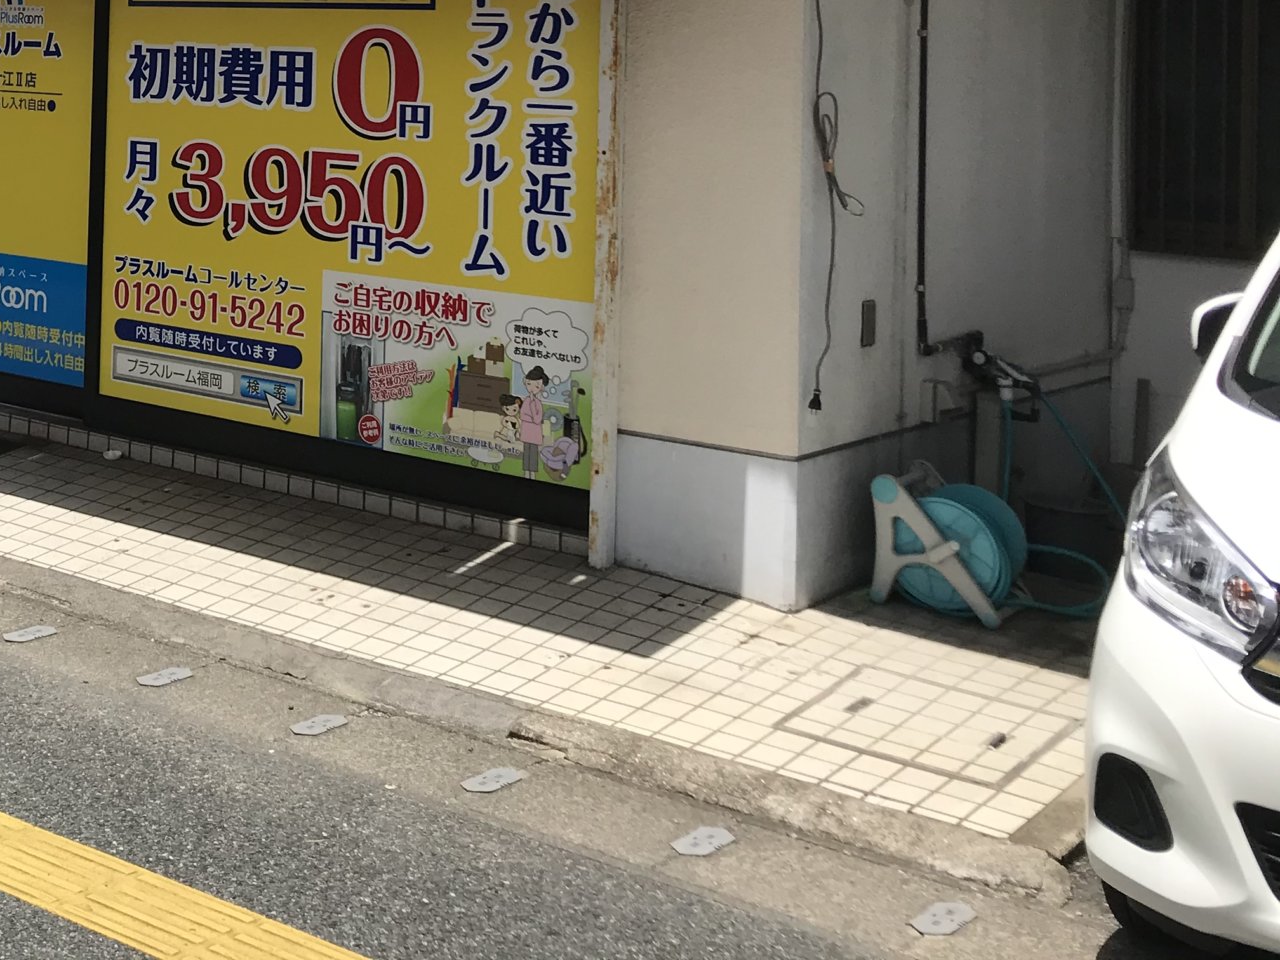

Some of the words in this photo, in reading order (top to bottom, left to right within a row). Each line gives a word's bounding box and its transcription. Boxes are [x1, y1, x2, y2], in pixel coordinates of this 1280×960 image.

[1, 12, 44, 24] PlusRoom
[128, 45, 315, 108] 初期費用
[333, 28, 431, 139] 0円
[126, 141, 157, 222] 月々
[115, 256, 306, 294] プラスルームコールセンター
[114, 279, 306, 337] 0120-91-5242
[334, 282, 493, 323] ご自宅の収納で
[136, 325, 277, 361] 内覧随時受付しています
[333, 310, 456, 346] お困りの方へ
[127, 358, 222, 389] プラスルーム福岡
